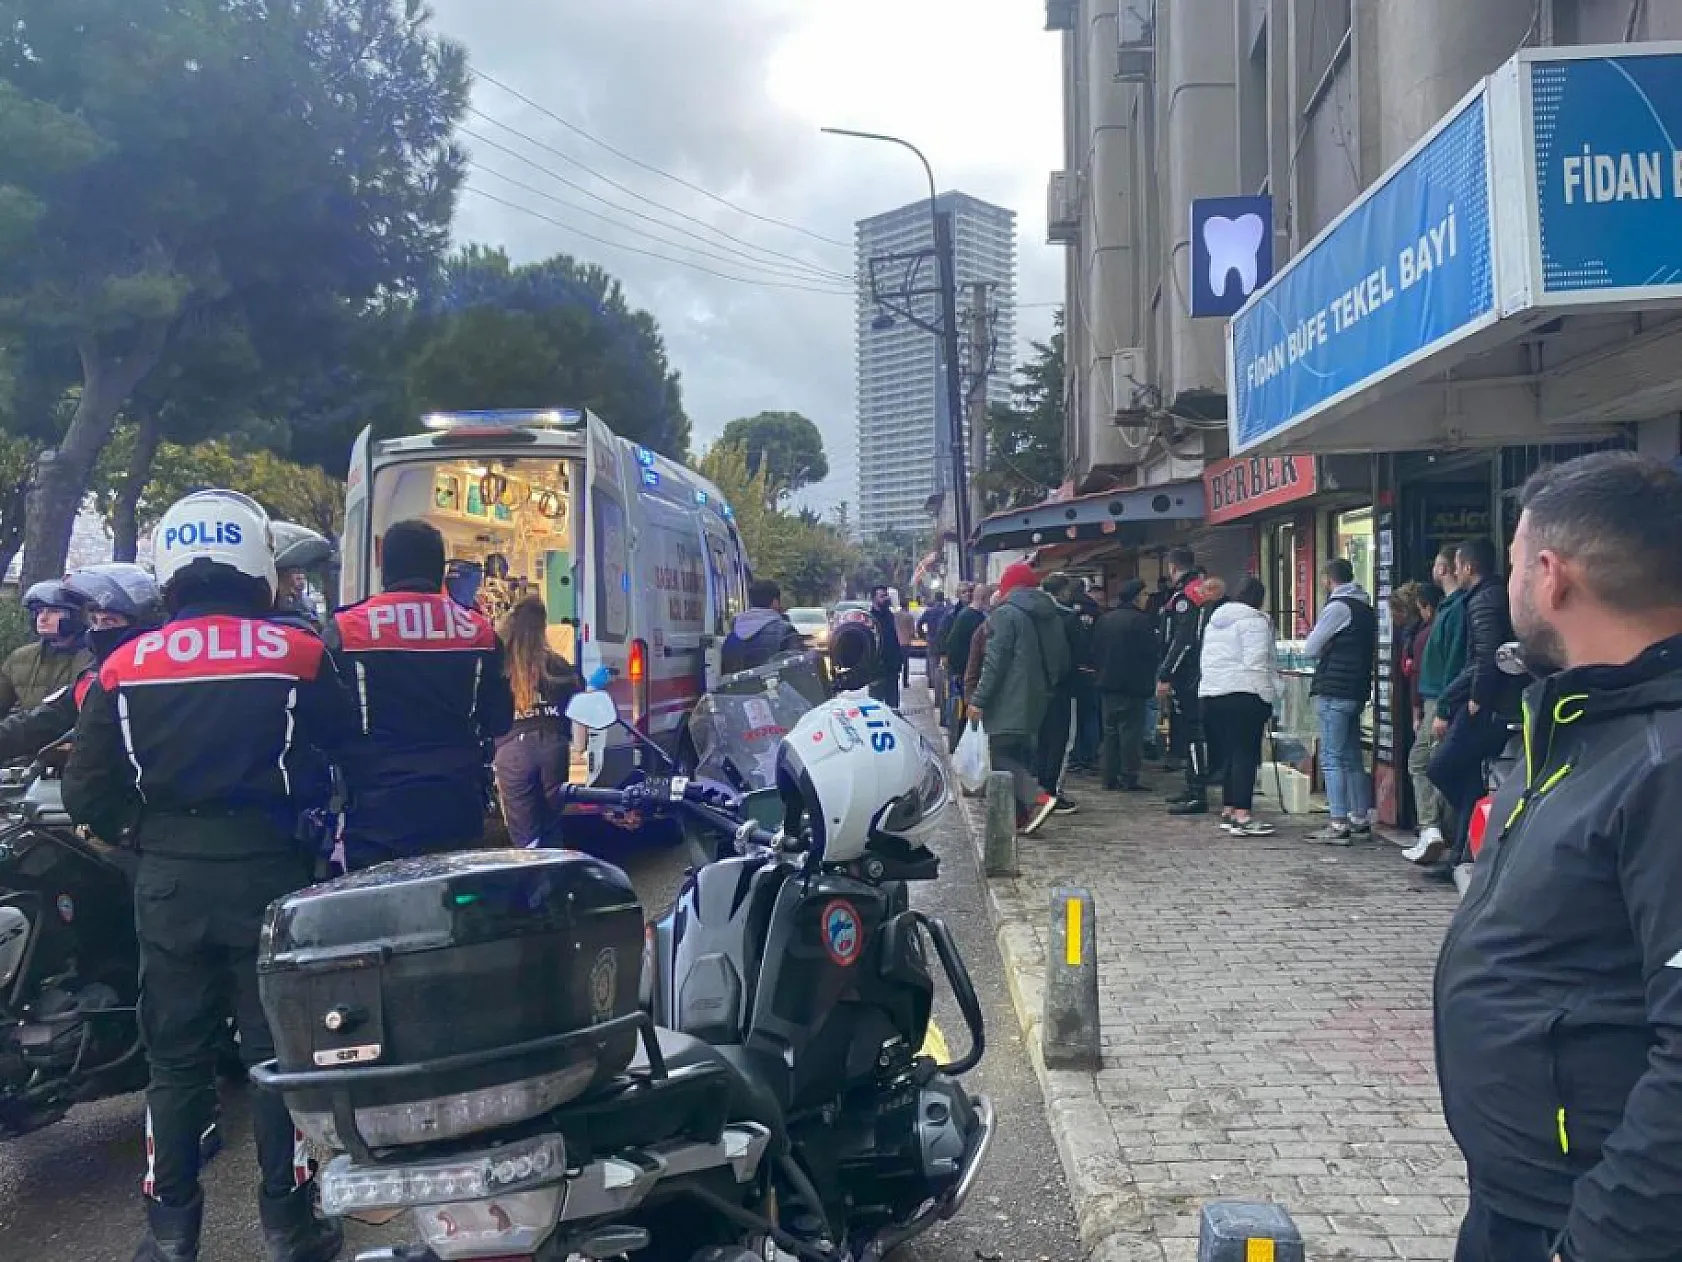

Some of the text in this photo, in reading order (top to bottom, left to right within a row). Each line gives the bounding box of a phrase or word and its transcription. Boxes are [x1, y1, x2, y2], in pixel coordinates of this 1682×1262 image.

[1563, 143, 1662, 205] FİDAN
[1287, 309, 1328, 365] BÜFE
[1330, 265, 1394, 334] TEKEL
[1399, 203, 1458, 290] BAYİ
